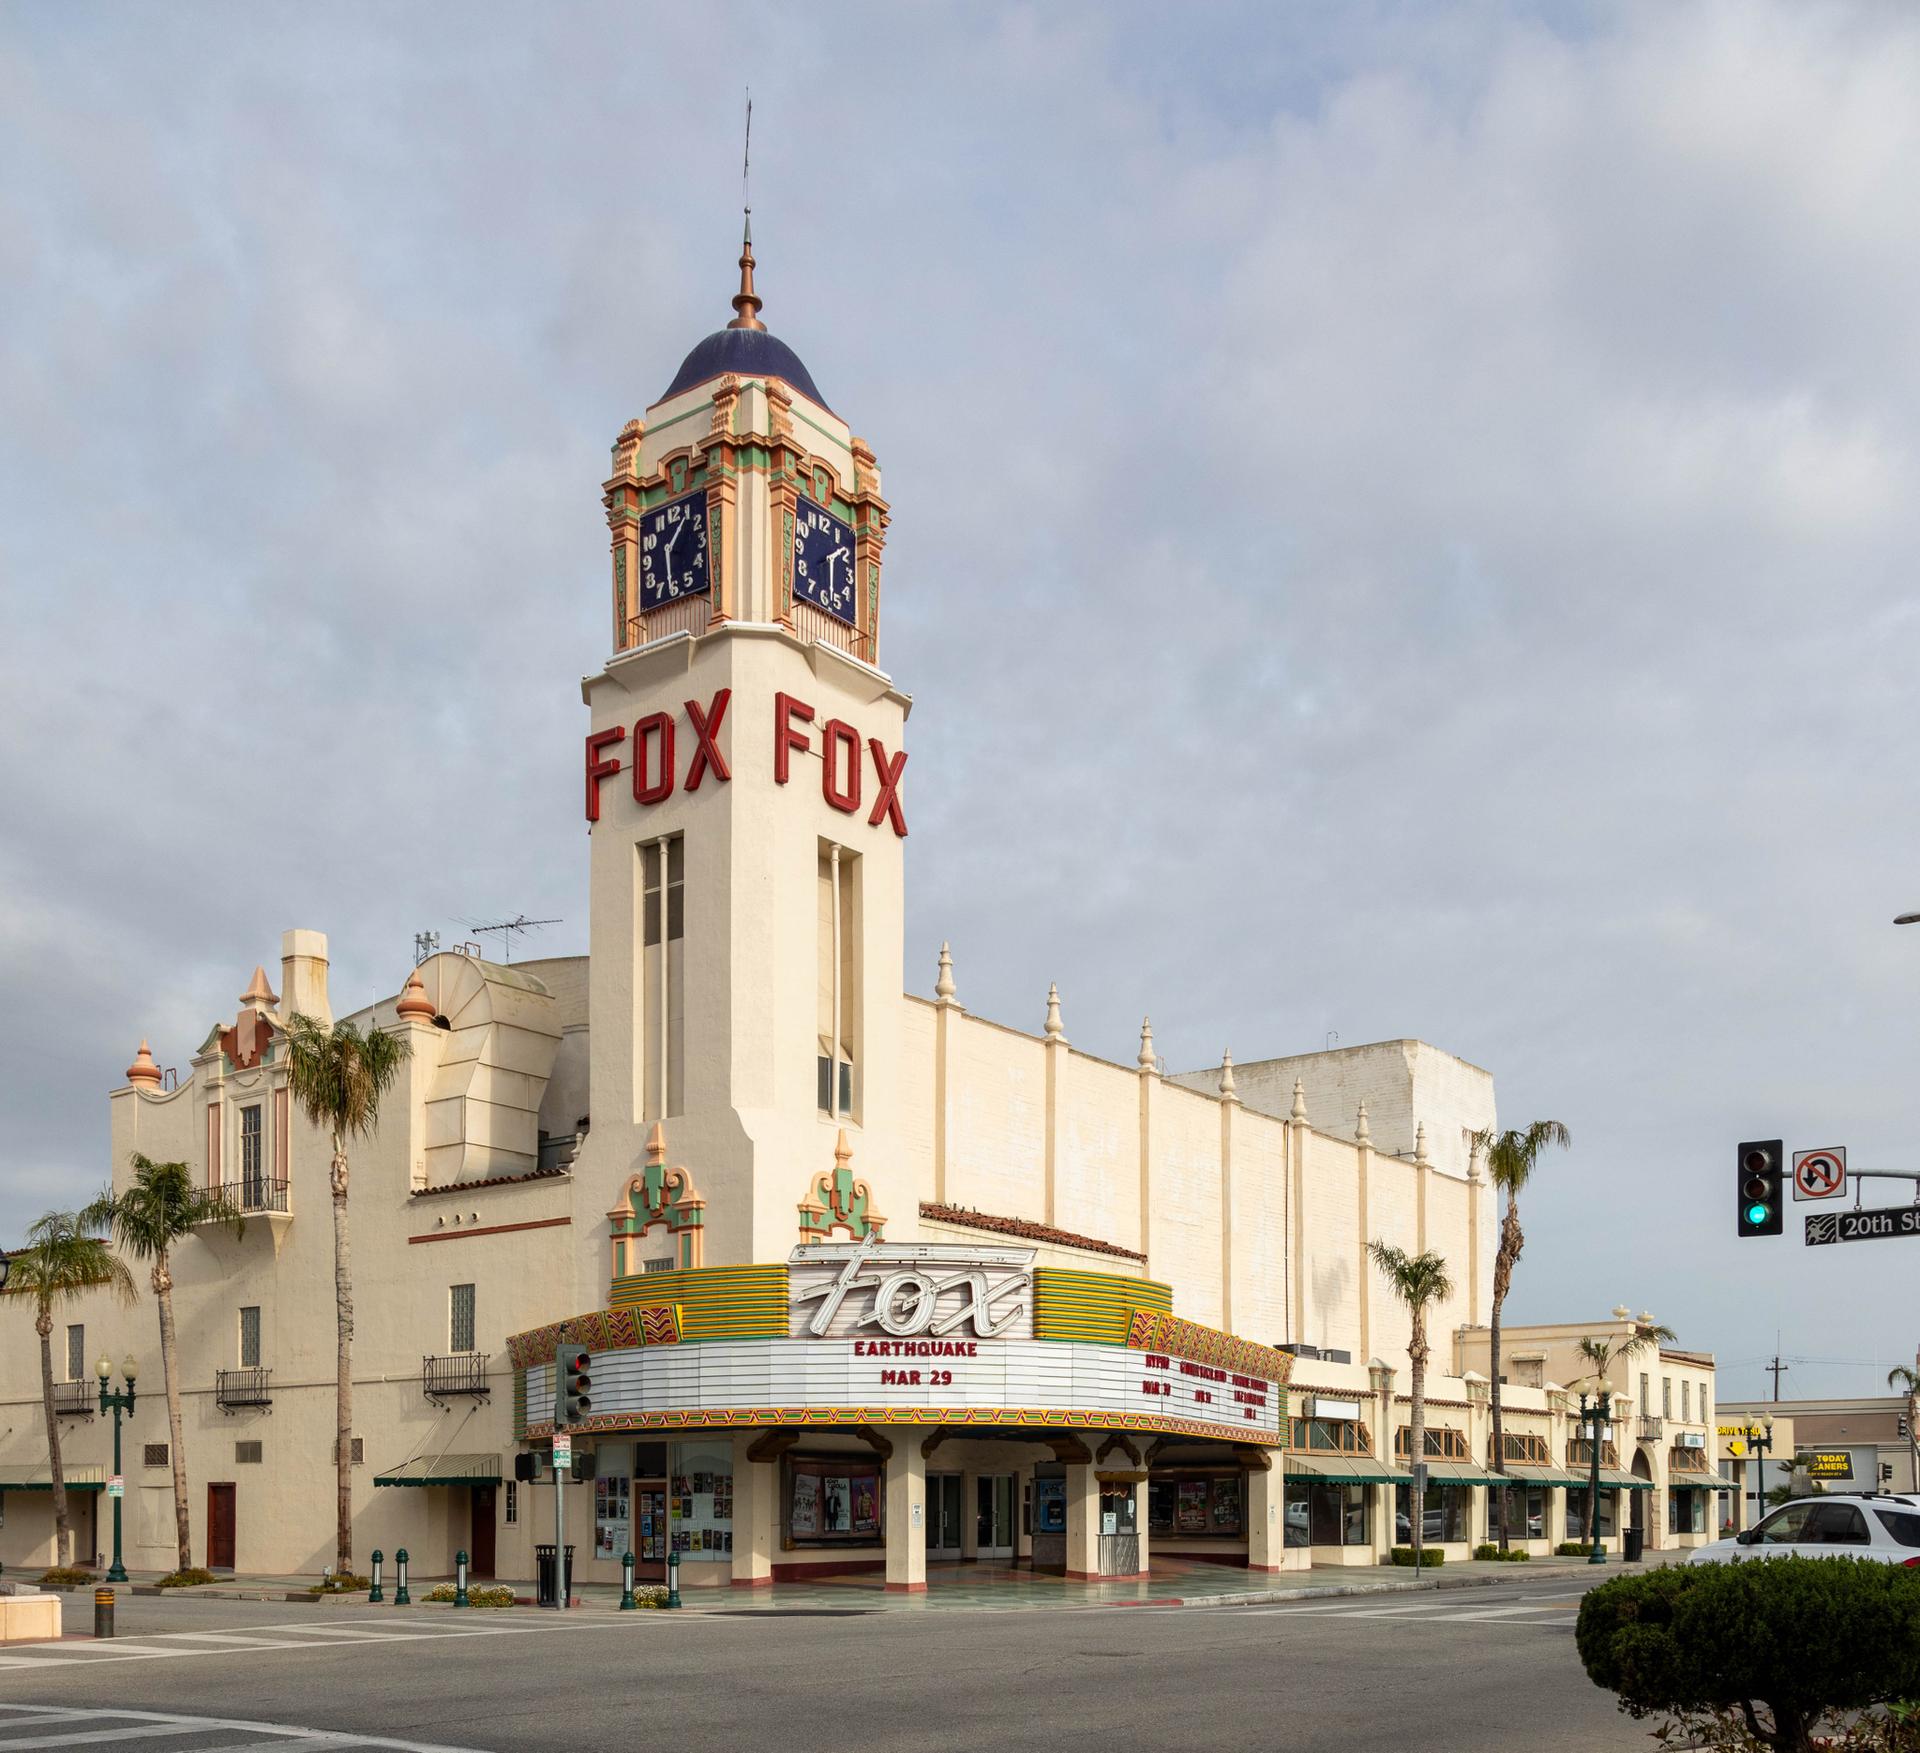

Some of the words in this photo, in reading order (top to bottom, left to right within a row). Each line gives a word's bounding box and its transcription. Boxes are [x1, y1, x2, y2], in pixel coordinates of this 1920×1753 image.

[667, 505, 680, 524] 12
[684, 504, 691, 520] 1
[807, 511, 817, 529] 11
[655, 514, 665, 533] 11
[693, 514, 702, 532] 2
[796, 518, 809, 539] 10
[819, 514, 830, 535] 12
[643, 533, 657, 552] 10
[698, 531, 706, 548] 3
[835, 527, 840, 544] 1
[795, 538, 804, 555] 9
[643, 555, 652, 571] 9
[693, 552, 704, 568] 4
[842, 547, 850, 564] 2
[798, 560, 807, 577] 8
[845, 567, 854, 585] 3
[645, 572, 656, 589] 8
[683, 570, 694, 588] 5
[808, 578, 817, 594] 7
[656, 582, 665, 599] 7
[669, 580, 679, 597] 6
[842, 586, 851, 602] 4
[820, 590, 829, 607] 6
[833, 592, 842, 610] 5
[585, 688, 731, 821] FOX
[774, 691, 908, 837] FOX
[1845, 1215, 1893, 1236] 20th
[854, 1341, 978, 1357] EARTHQUAKE
[881, 1370, 921, 1385] MAR
[929, 1369, 952, 1385] 29
[1716, 1426, 1739, 1435] DRIVE
[1816, 1454, 1846, 1463] TODAY
